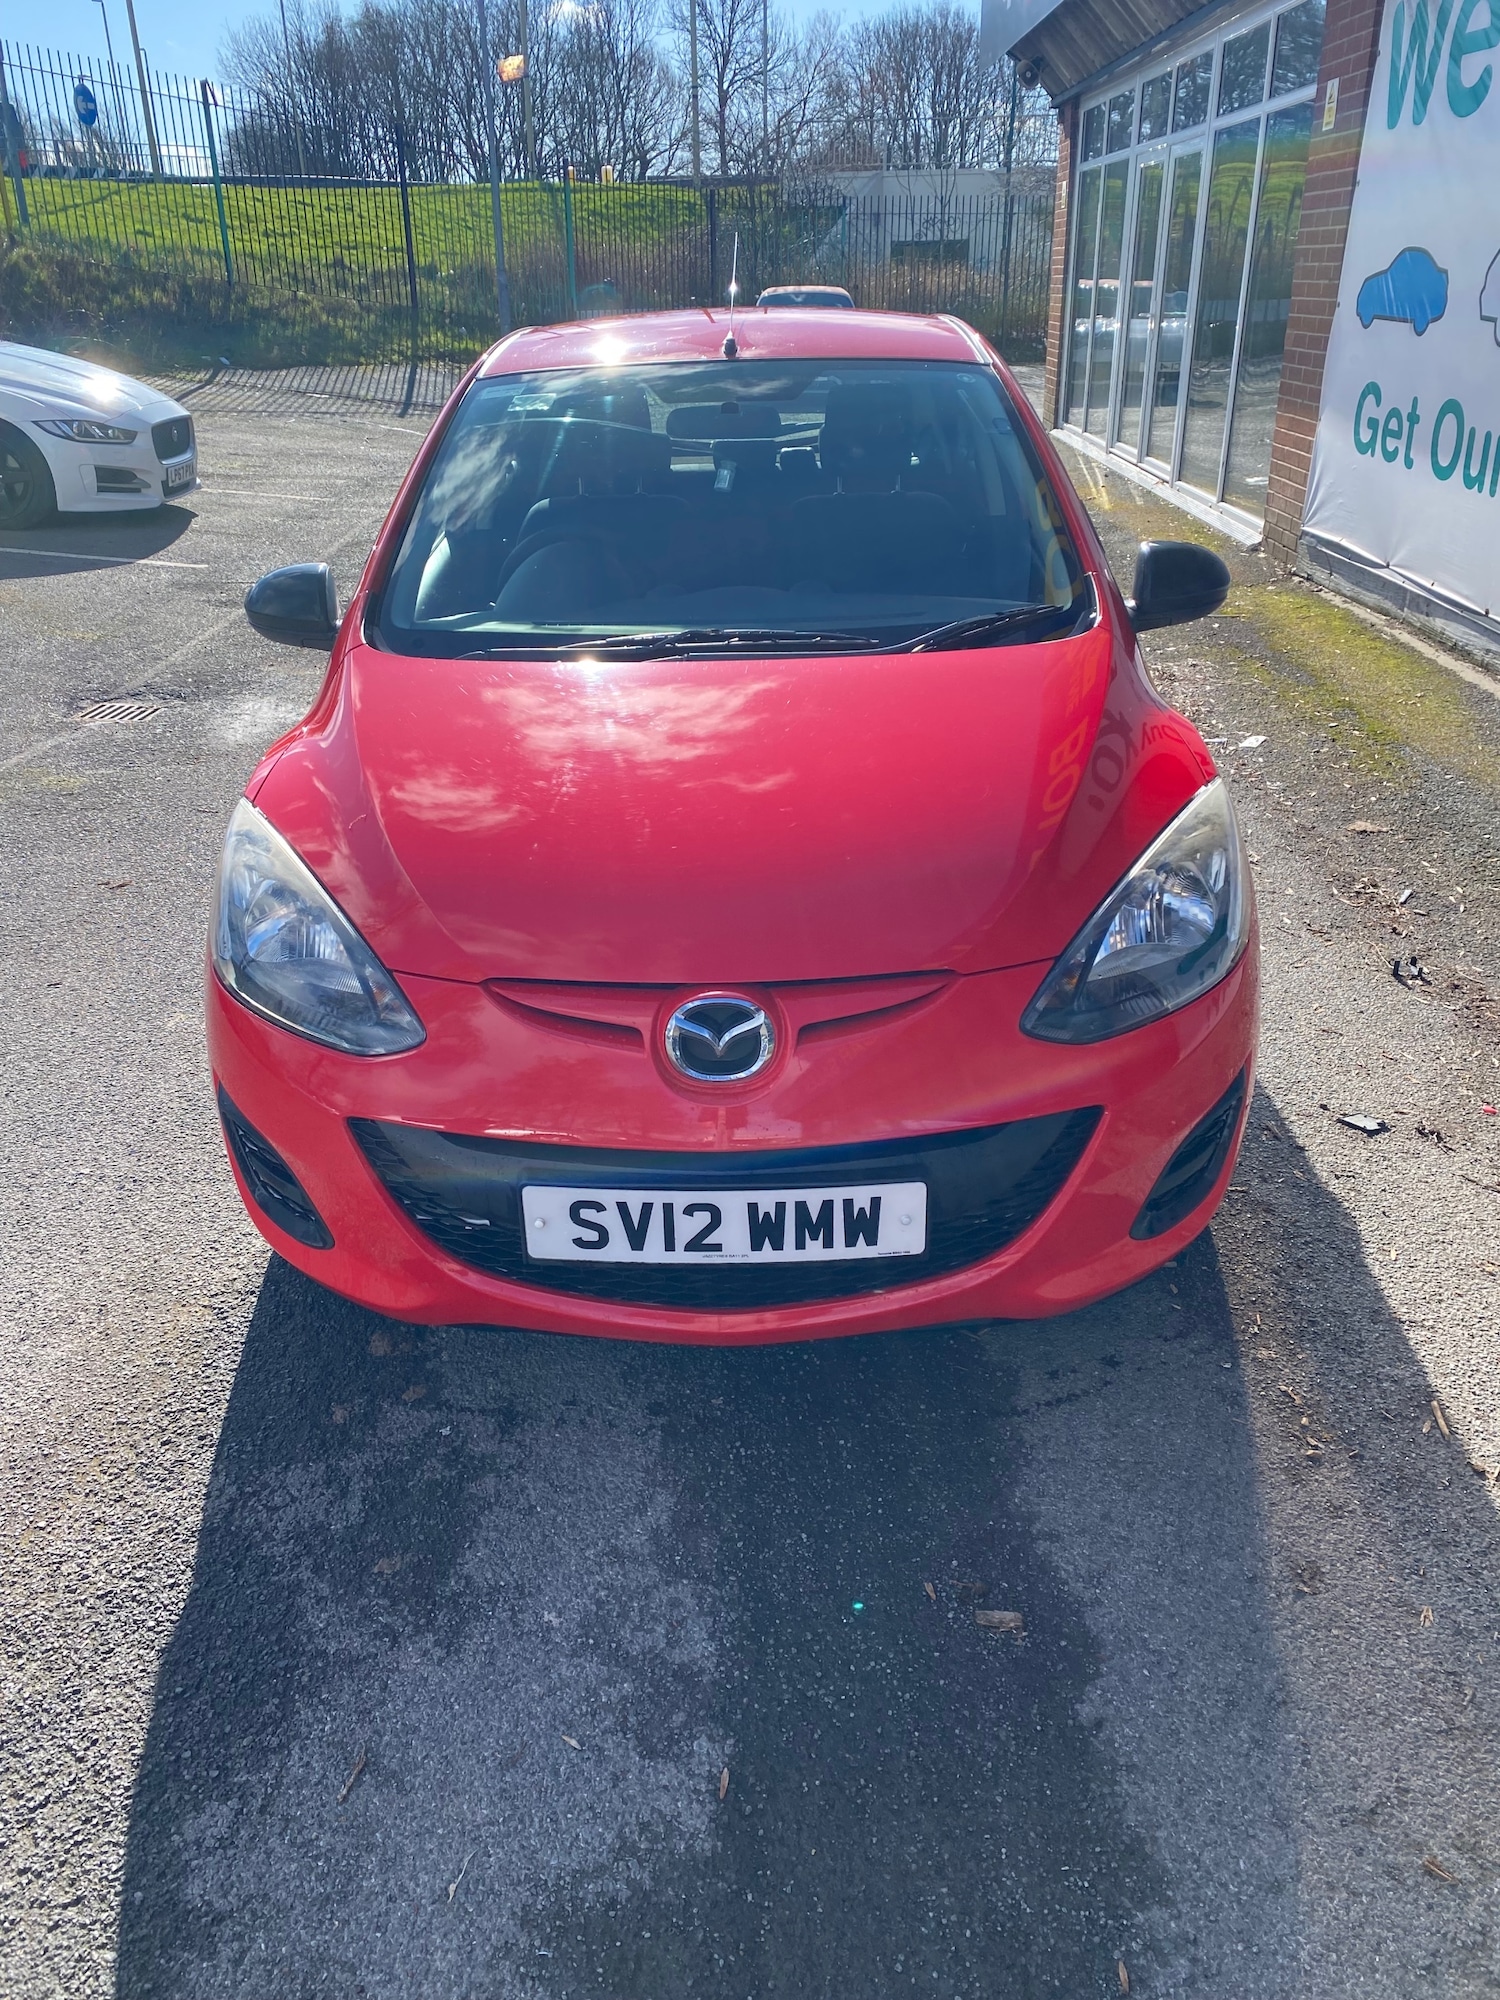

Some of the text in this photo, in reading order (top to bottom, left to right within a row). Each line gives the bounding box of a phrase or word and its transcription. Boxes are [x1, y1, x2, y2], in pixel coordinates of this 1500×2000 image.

[1387, 0, 1500, 130] We
[1353, 381, 1420, 470] Get
[569, 1196, 882, 1252] SV12 WMW
